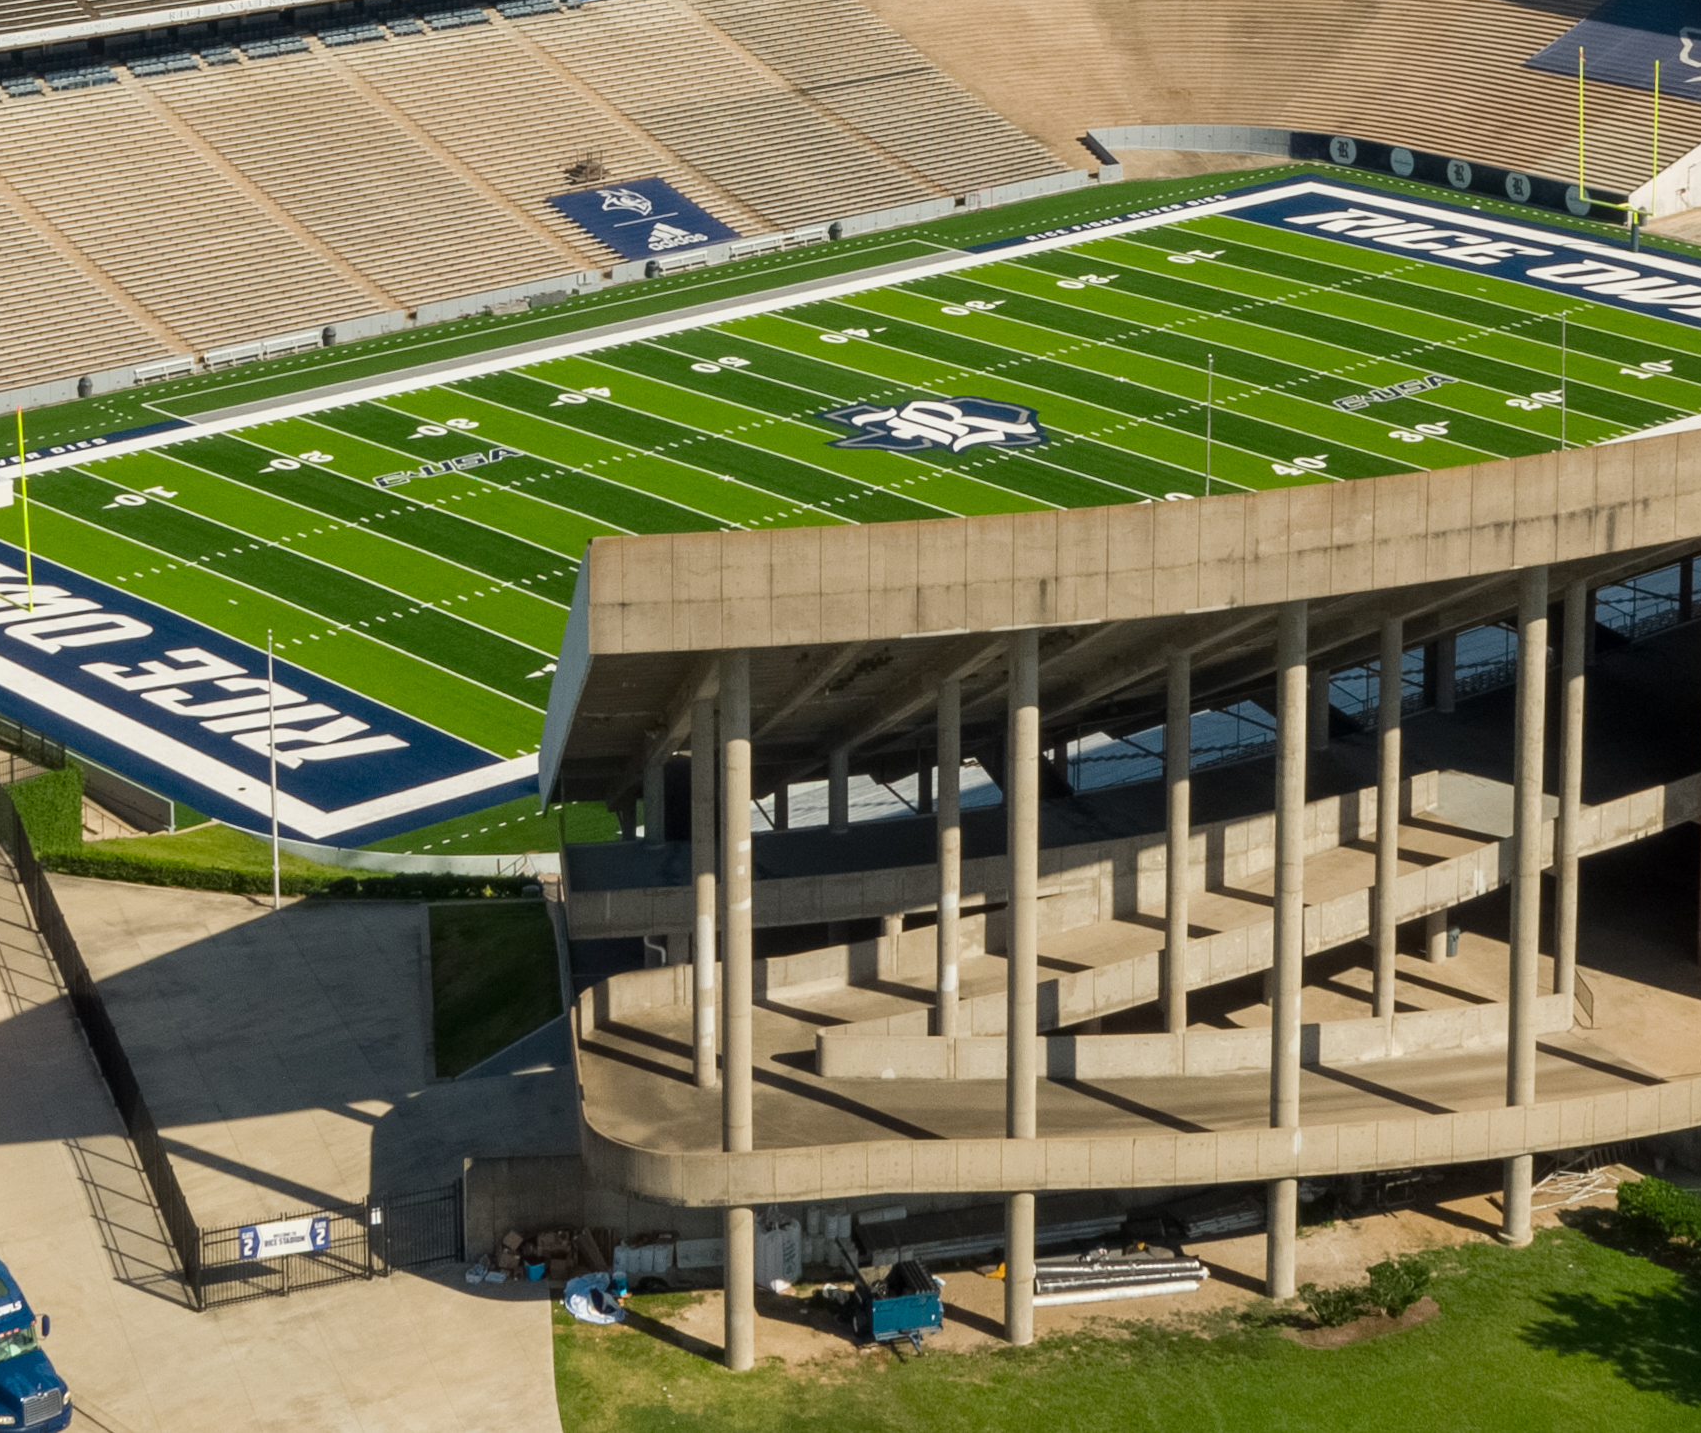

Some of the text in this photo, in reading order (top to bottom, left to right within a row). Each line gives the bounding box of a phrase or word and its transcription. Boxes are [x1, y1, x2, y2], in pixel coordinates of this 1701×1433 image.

[1025, 193, 1229, 243] RICE FIGHT NEVER DIES
[648, 233, 709, 251] adidas
[1283, 207, 1555, 266] RICE
[1167, 250, 1216, 265] 10
[1056, 274, 1111, 290] 20
[940, 300, 997, 316] 30
[819, 328, 870, 345] 40
[690, 356, 752, 374] 50
[1619, 361, 1673, 379] 10
[557, 386, 611, 405] 40
[1505, 392, 1563, 411] 20
[416, 418, 480, 437] 30
[1388, 424, 1449, 443] 30
[49, 436, 109, 455] DIES
[270, 450, 334, 471] 20
[1271, 456, 1327, 476] 40
[115, 486, 178, 507] 10
[79, 646, 410, 770] RICE
[264, 1235, 306, 1248] RICE STADIUM
[315, 1228, 326, 1246] 2
[243, 1238, 253, 1257] 2
